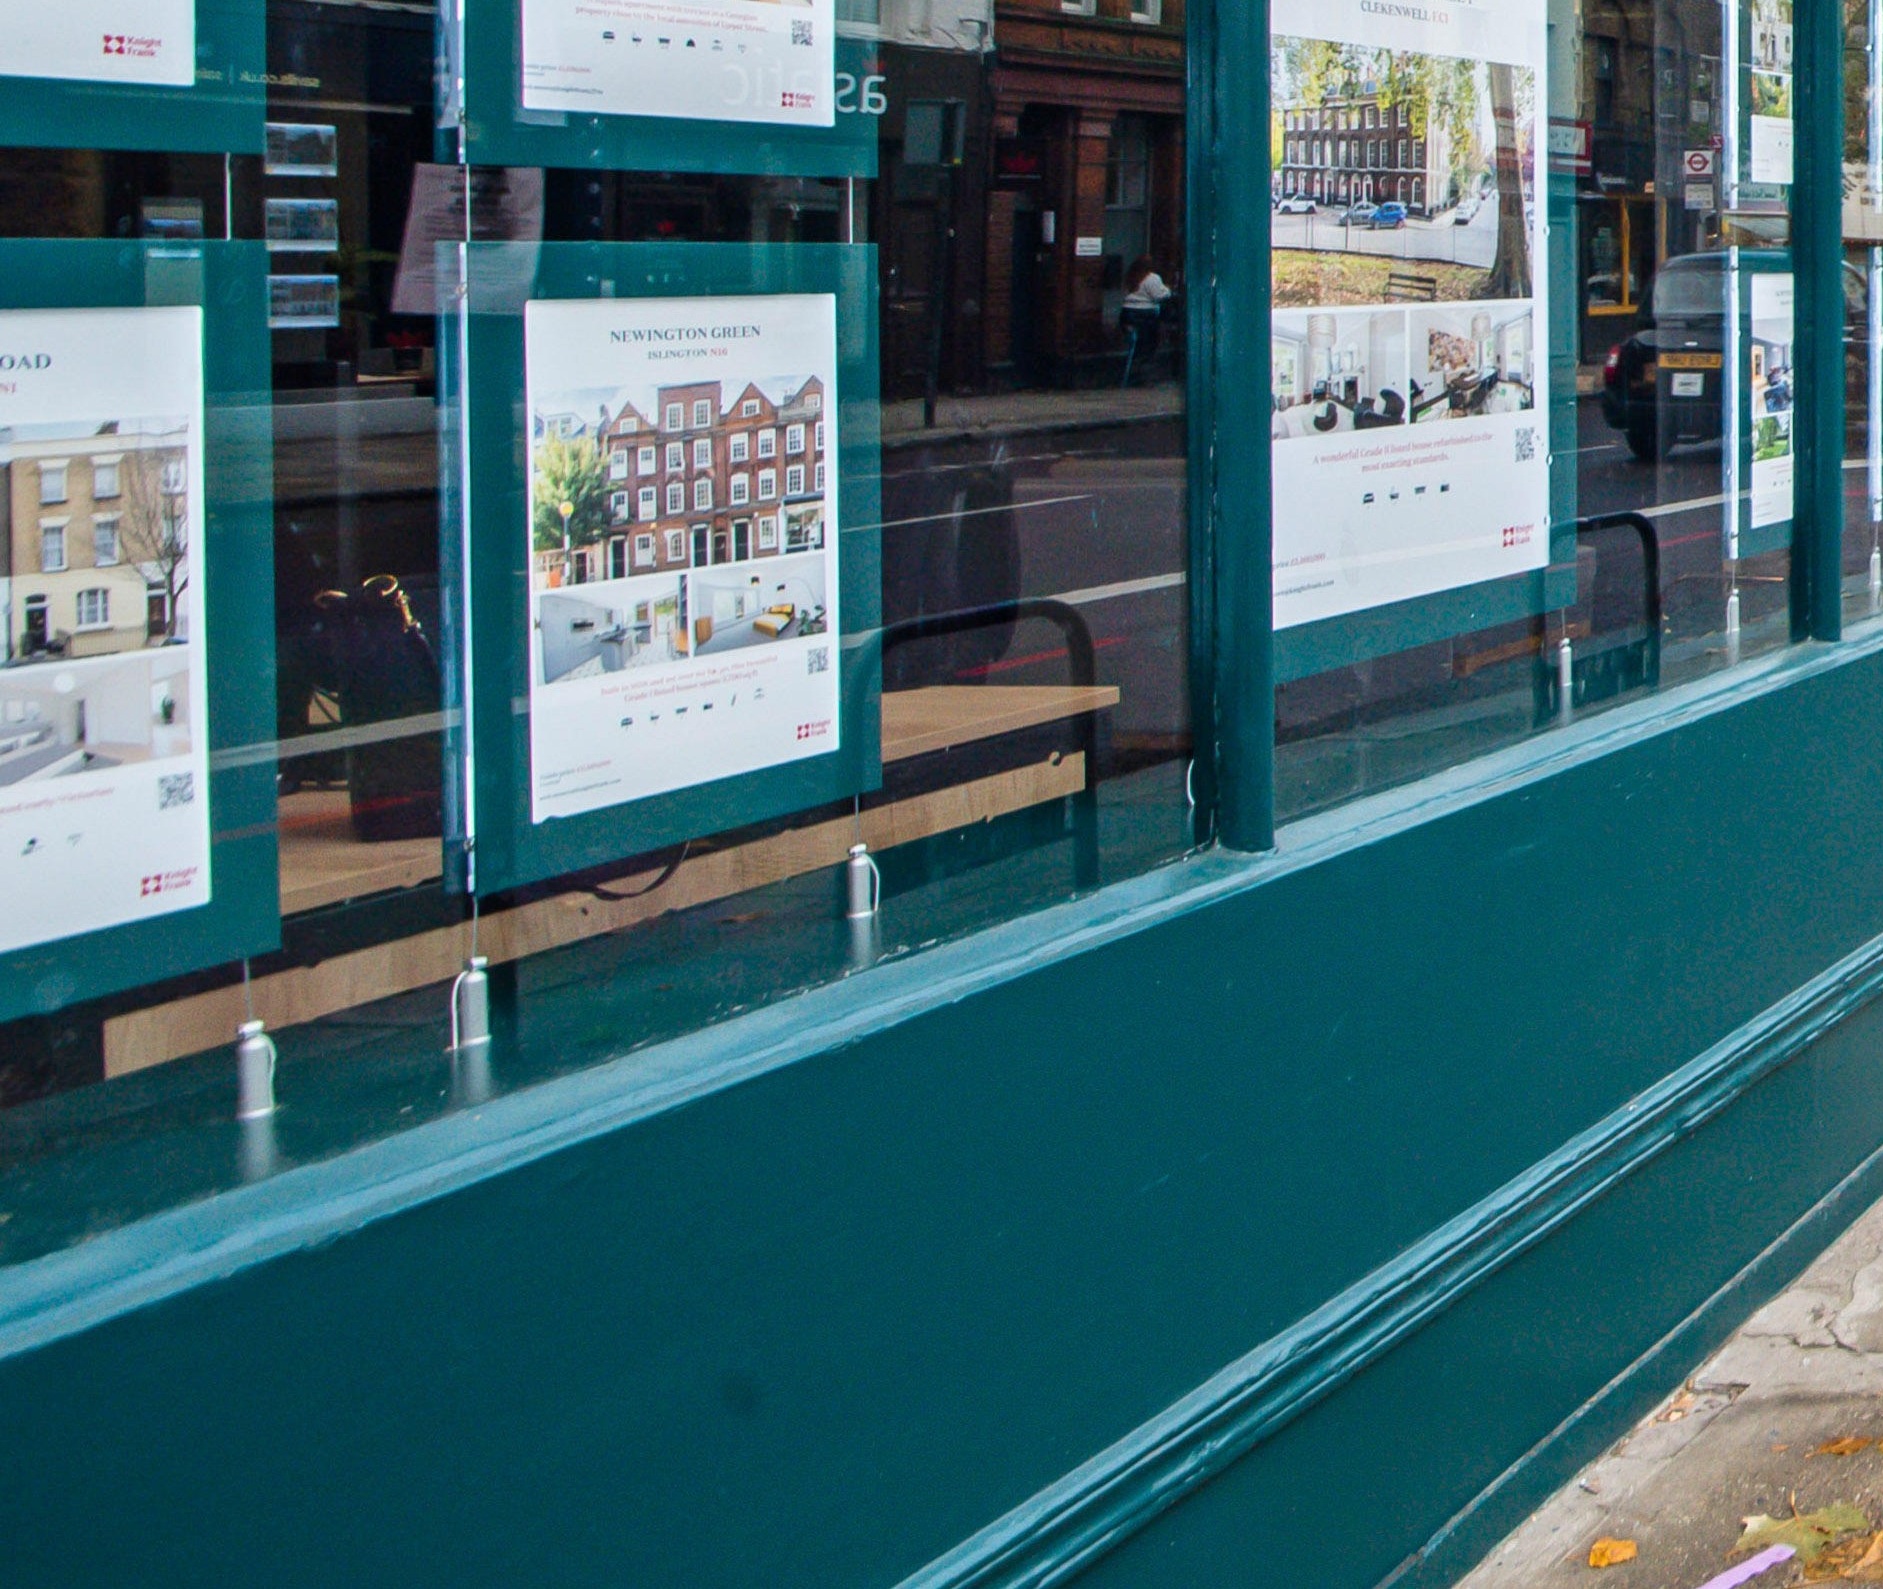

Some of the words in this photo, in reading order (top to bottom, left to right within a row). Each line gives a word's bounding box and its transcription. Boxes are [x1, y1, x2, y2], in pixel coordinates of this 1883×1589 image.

[610, 327, 707, 344] NEWINGTON
[711, 325, 760, 340] GREEN
[0, 353, 52, 370] OAD
[648, 347, 707, 360] ISLINGTON
